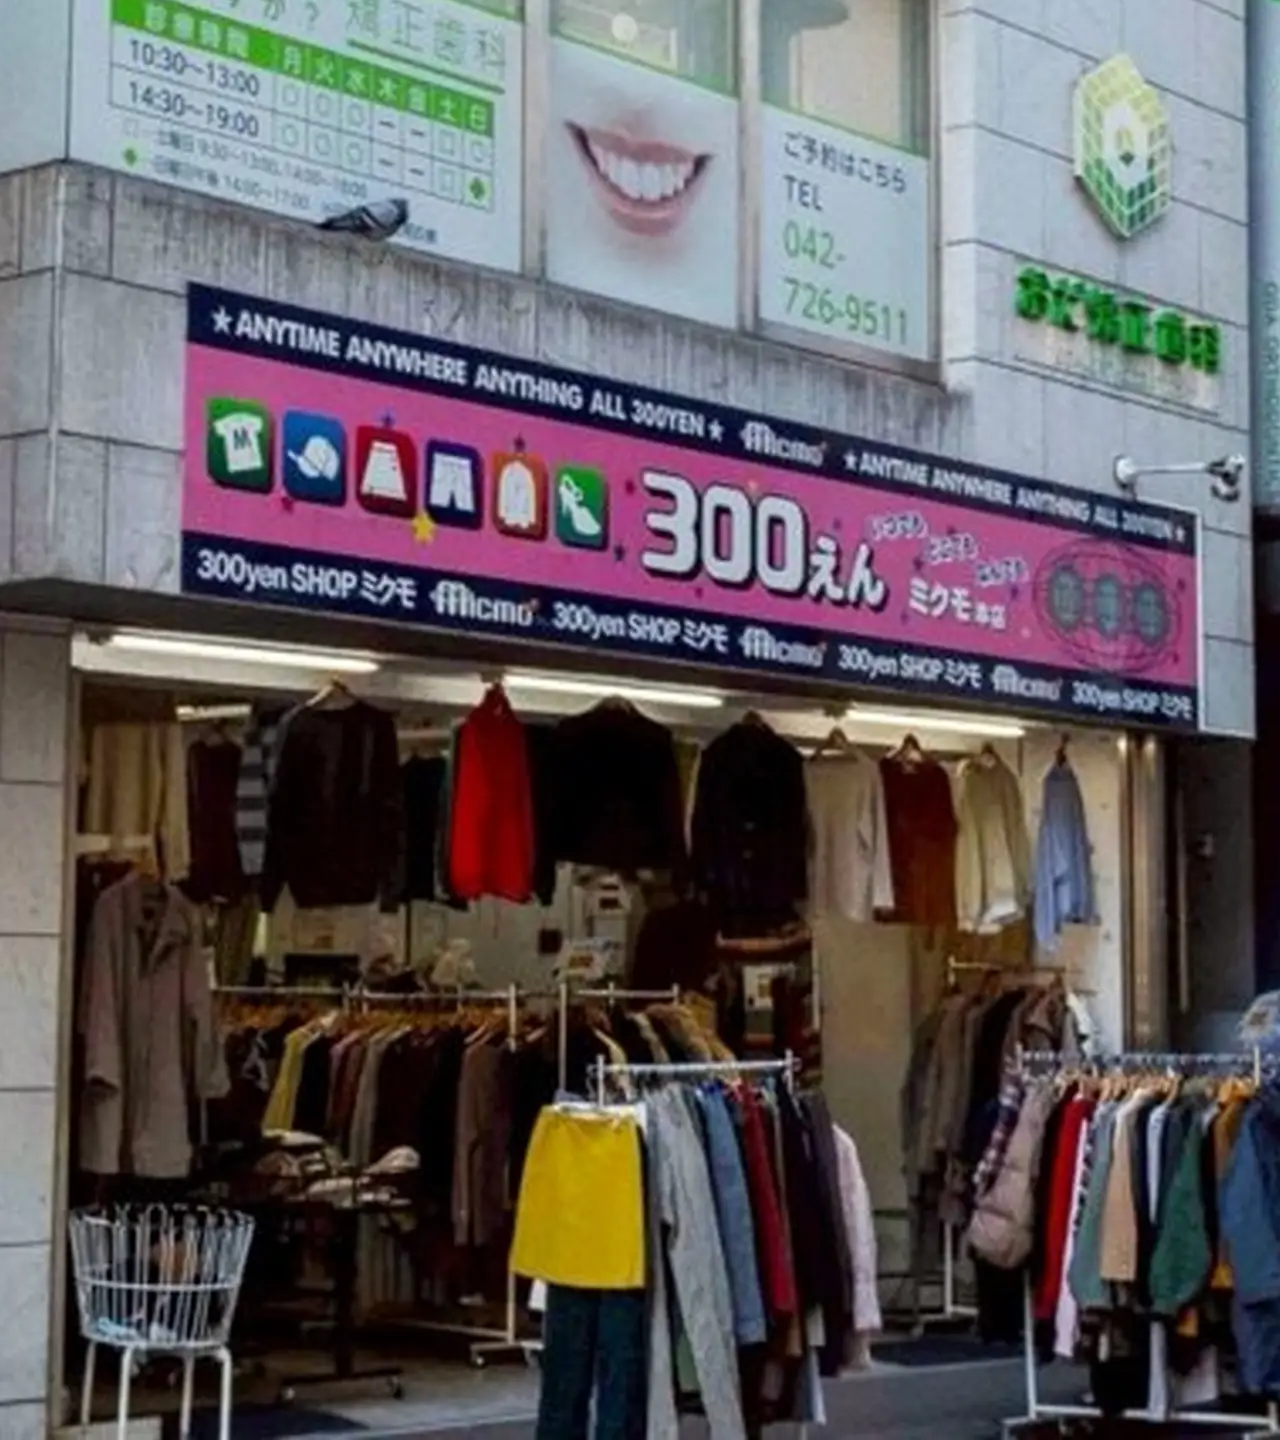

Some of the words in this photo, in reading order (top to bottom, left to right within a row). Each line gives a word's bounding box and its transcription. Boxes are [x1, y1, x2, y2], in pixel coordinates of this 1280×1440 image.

[783, 173, 824, 212] TEL
[785, 131, 907, 195] ご予約はこちら
[783, 219, 847, 270] 042-
[784, 275, 907, 345] 726-9511
[235, 308, 341, 358] ANYTIME
[346, 335, 468, 386] ANYWHERE
[474, 363, 583, 411] ANYTHING
[589, 389, 626, 421] ALL
[631, 399, 705, 439] 300YEN
[859, 453, 930, 486] ANYTIME
[931, 466, 1014, 507] ANYWHERE
[1015, 485, 1090, 524] ANYTHING
[641, 470, 886, 608] 300えん
[196, 548, 288, 593] 300yen
[291, 562, 358, 600] SHOP
[360, 570, 418, 609] ミクモ
[552, 601, 626, 640] 300yen
[628, 613, 682, 645] SHOP
[682, 618, 729, 654] ミクモ
[838, 643, 898, 680] 300yen
[900, 654, 943, 682] SHOP
[944, 660, 982, 690] ミクモ
[1072, 680, 1120, 711] 300yen
[1121, 686, 1160, 715] SHOP
